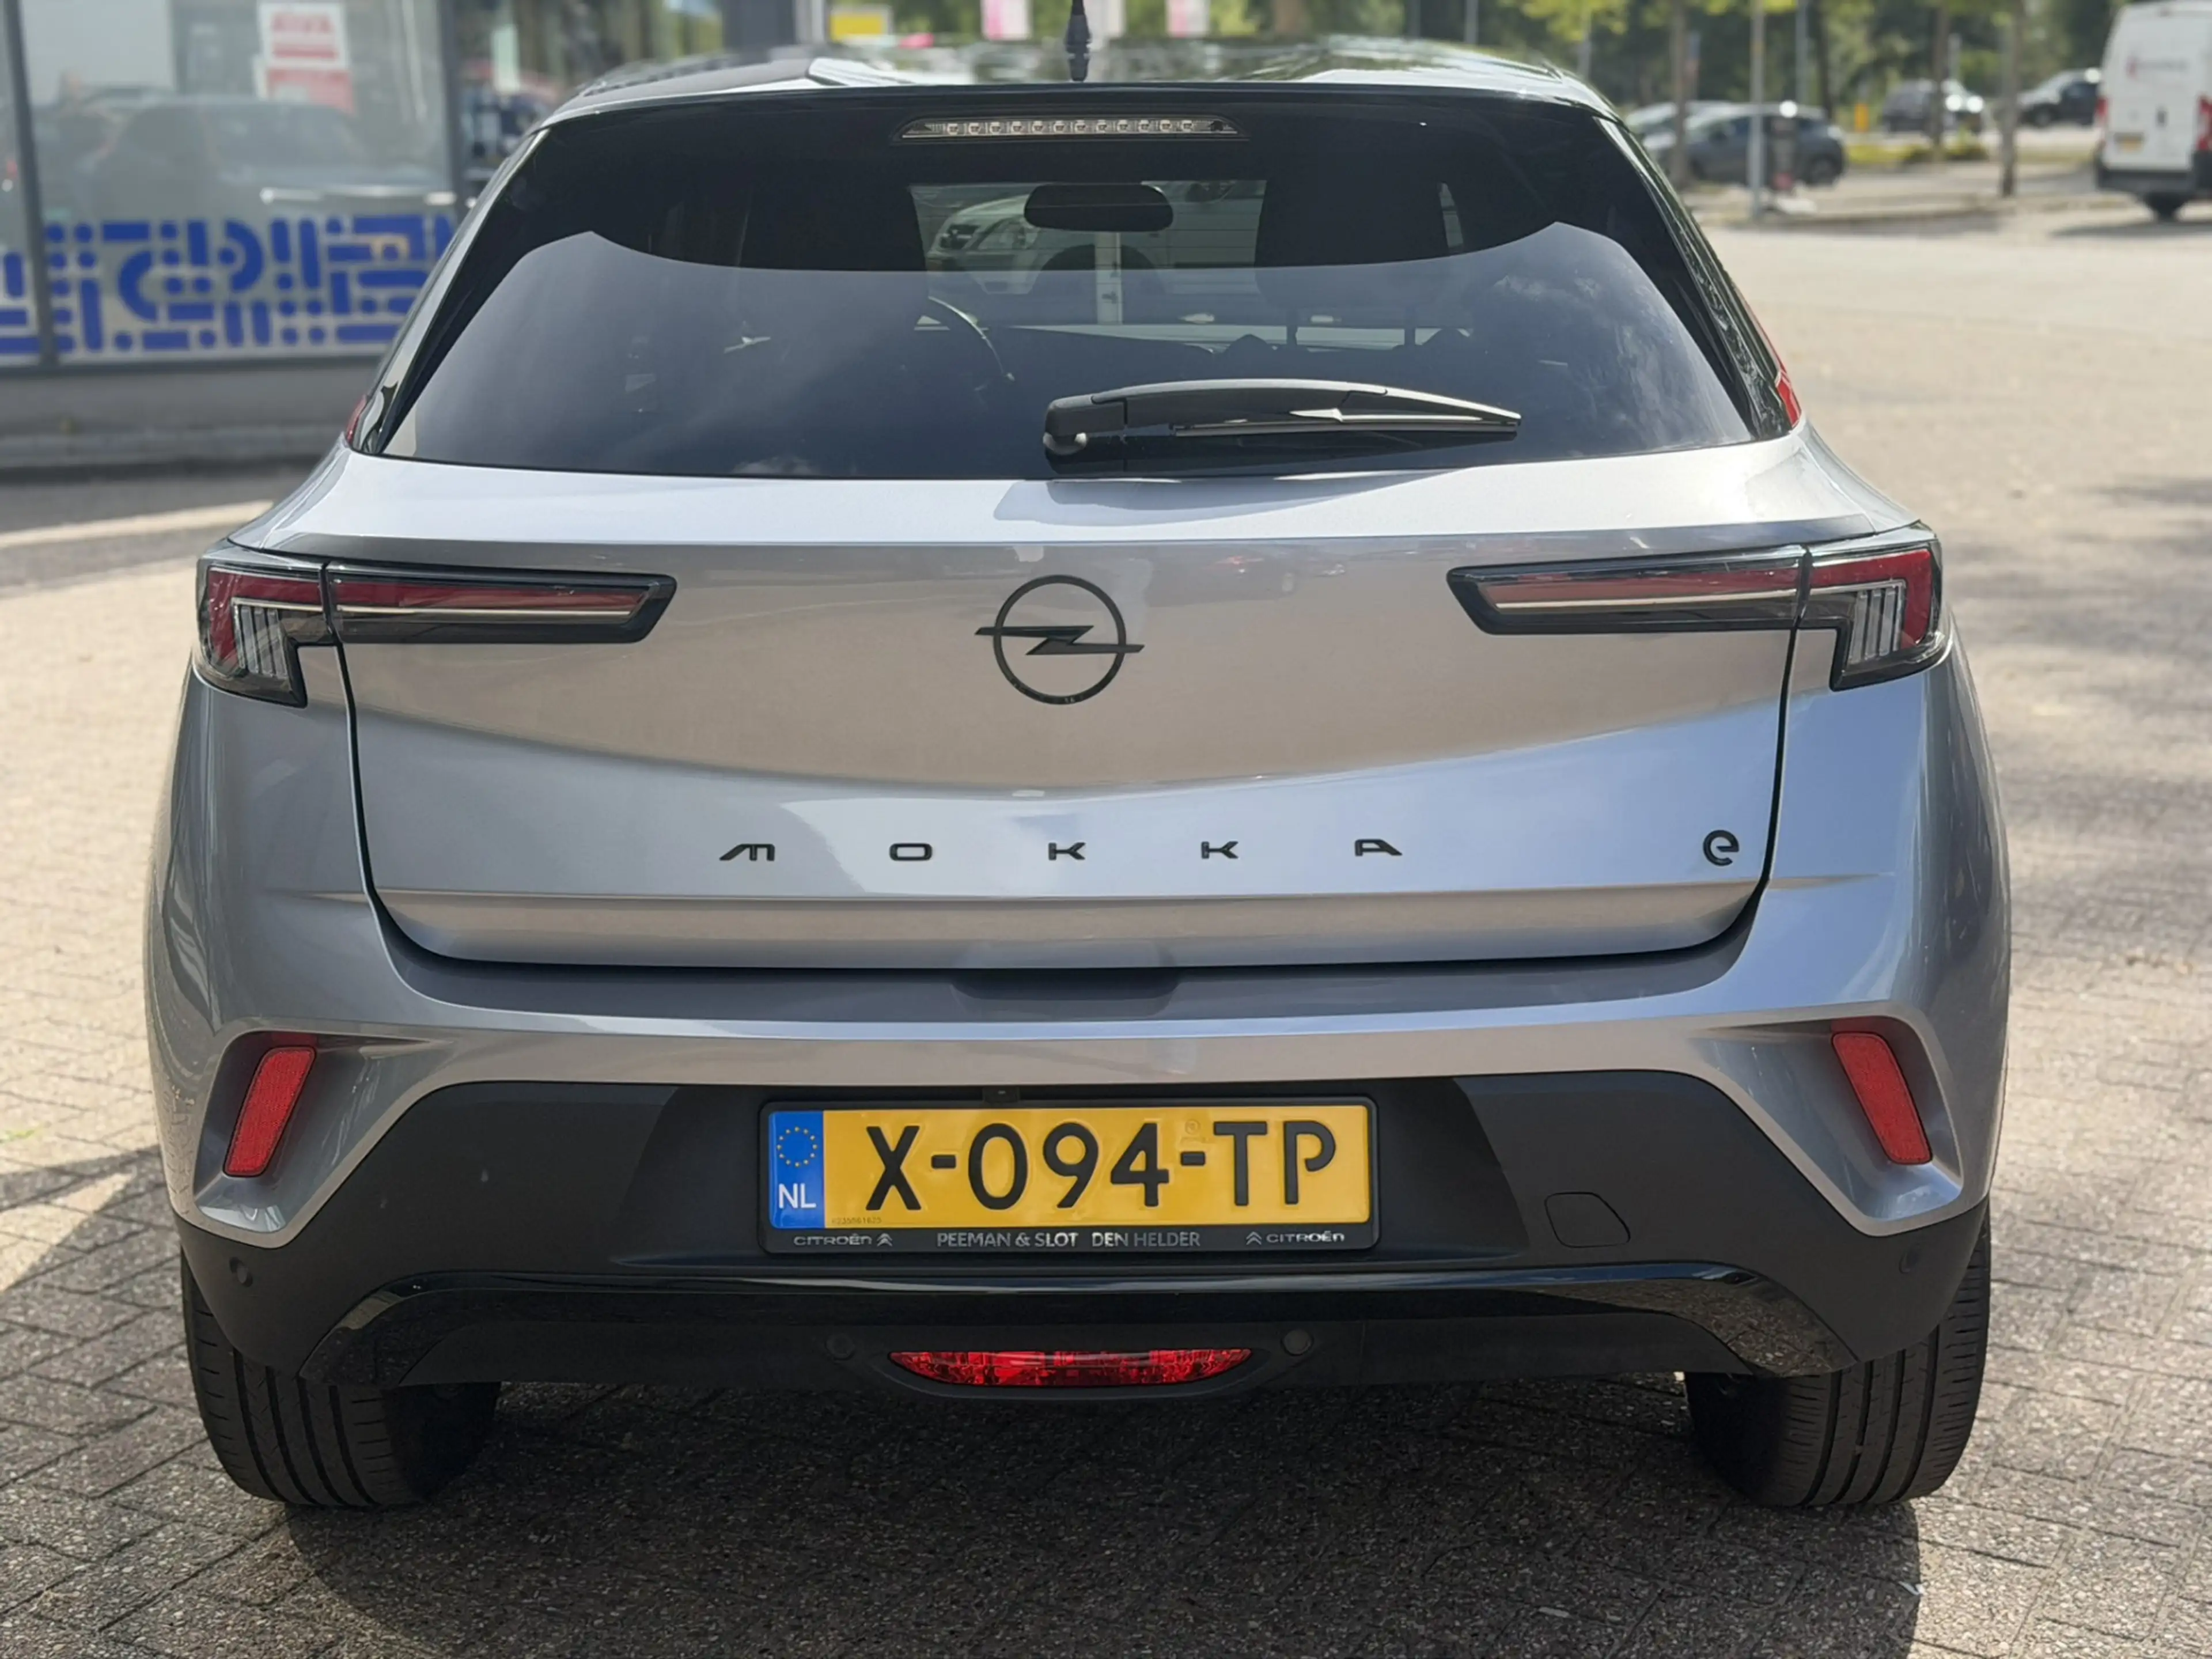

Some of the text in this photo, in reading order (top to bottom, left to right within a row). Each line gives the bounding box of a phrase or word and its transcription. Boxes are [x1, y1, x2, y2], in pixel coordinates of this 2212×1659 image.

[719, 839, 1403, 861] MOKKA
[866, 1120, 1336, 1211] X-094-TP
[778, 1183, 816, 1209] NL
[937, 1232, 1200, 1247] PEEMAN & SLOT DEN HELDER
